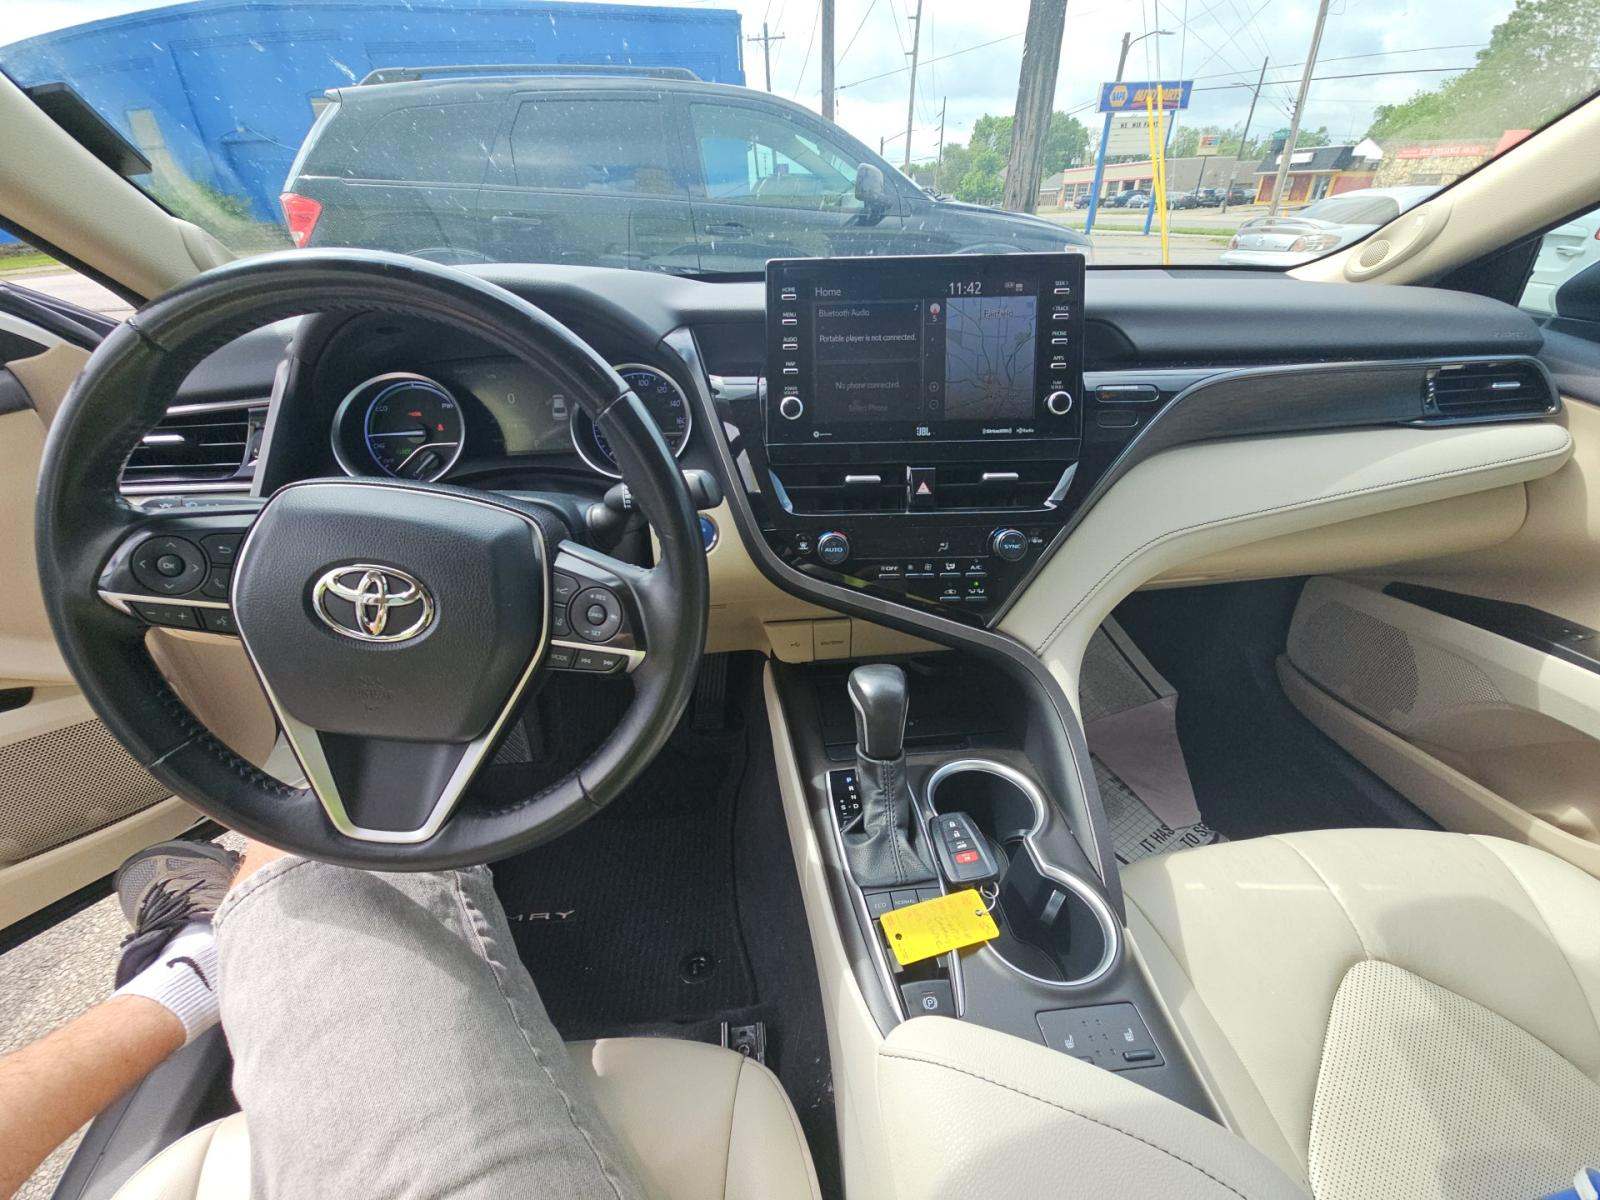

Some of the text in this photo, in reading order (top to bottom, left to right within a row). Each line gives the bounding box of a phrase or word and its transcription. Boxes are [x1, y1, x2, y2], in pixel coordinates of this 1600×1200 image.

[815, 287, 842, 297] Home
[948, 281, 982, 295] 11:42
[818, 309, 850, 318] Bluetooth
[819, 335, 845, 343] Portable
[845, 333, 864, 344] player
[871, 334, 882, 342] not
[846, 381, 866, 391] phone
[916, 427, 931, 436] JBL
[1139, 838, 1156, 853] IT
[1150, 824, 1176, 844] HAS
[1179, 832, 1200, 848] TO
